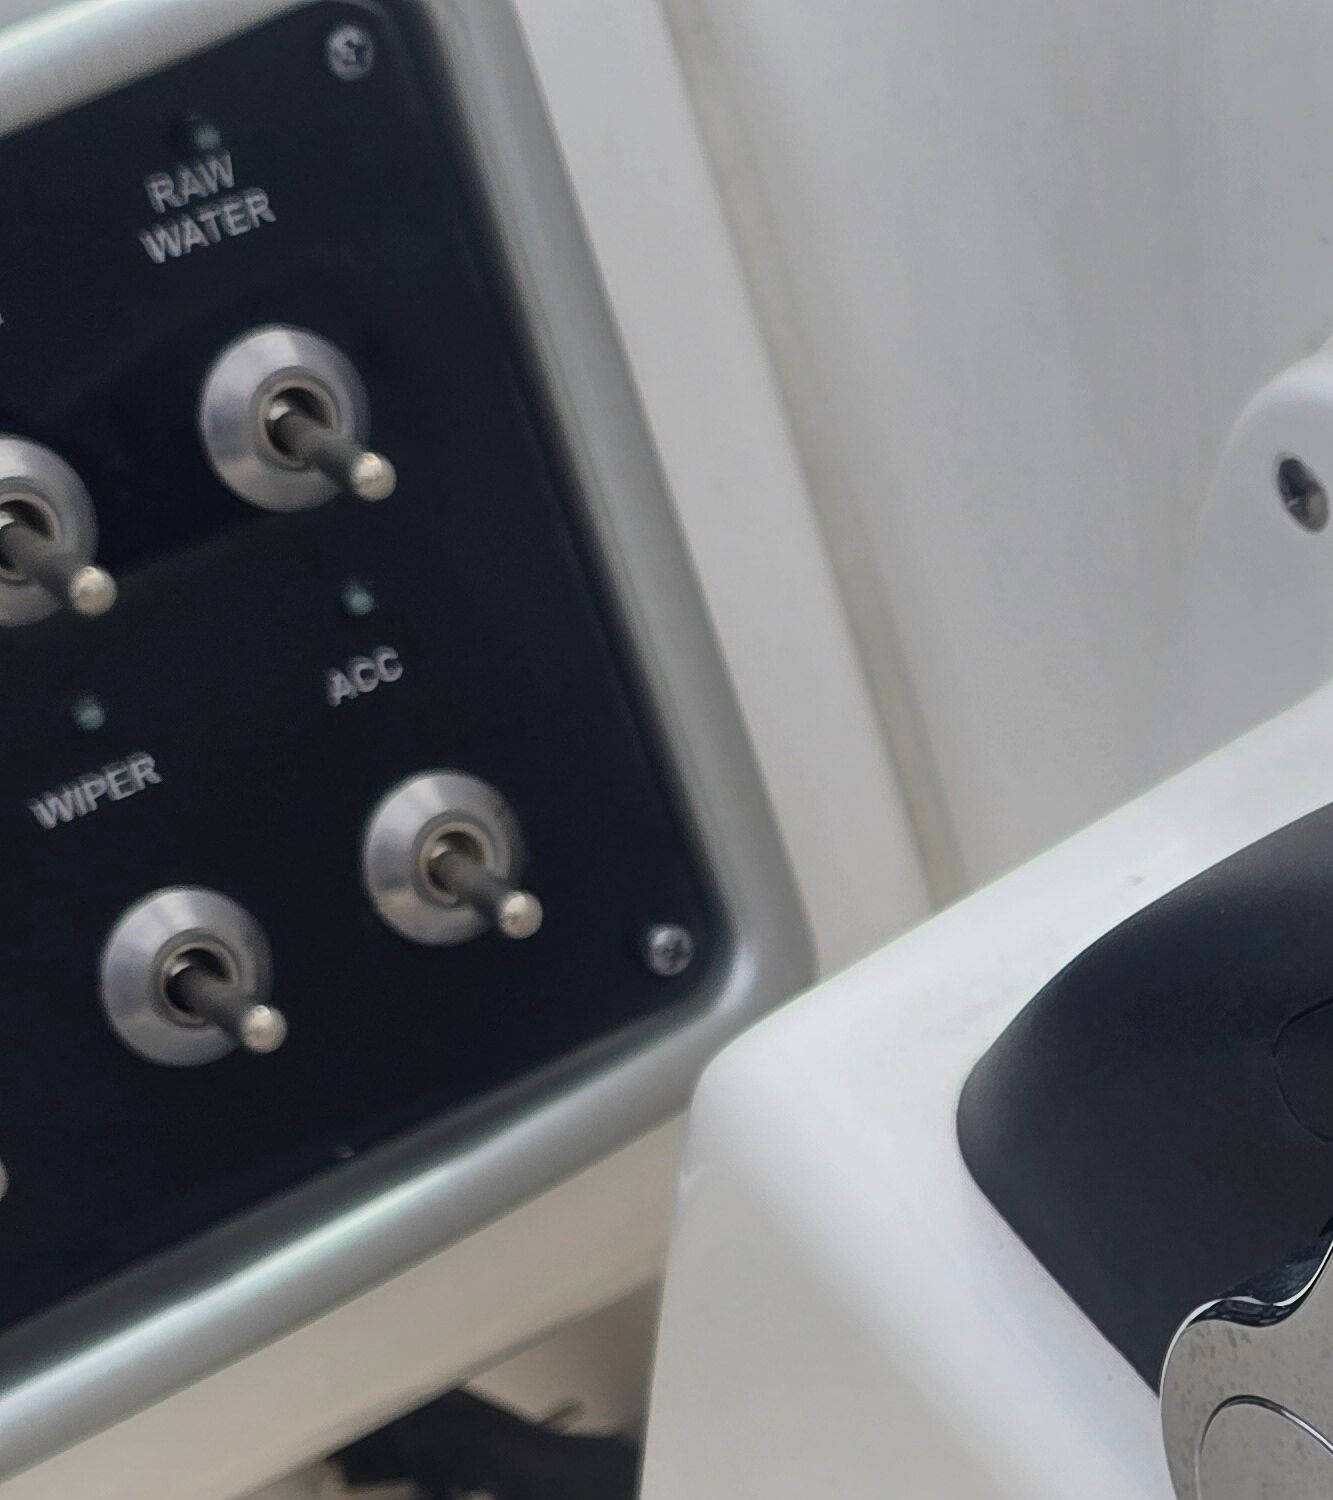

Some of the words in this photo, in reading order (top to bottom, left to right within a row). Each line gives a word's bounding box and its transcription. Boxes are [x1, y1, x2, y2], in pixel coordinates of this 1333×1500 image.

[144, 150, 235, 214] RAW
[137, 187, 277, 263] WATER
[323, 645, 403, 707] ACC
[28, 752, 163, 830] WIPER
